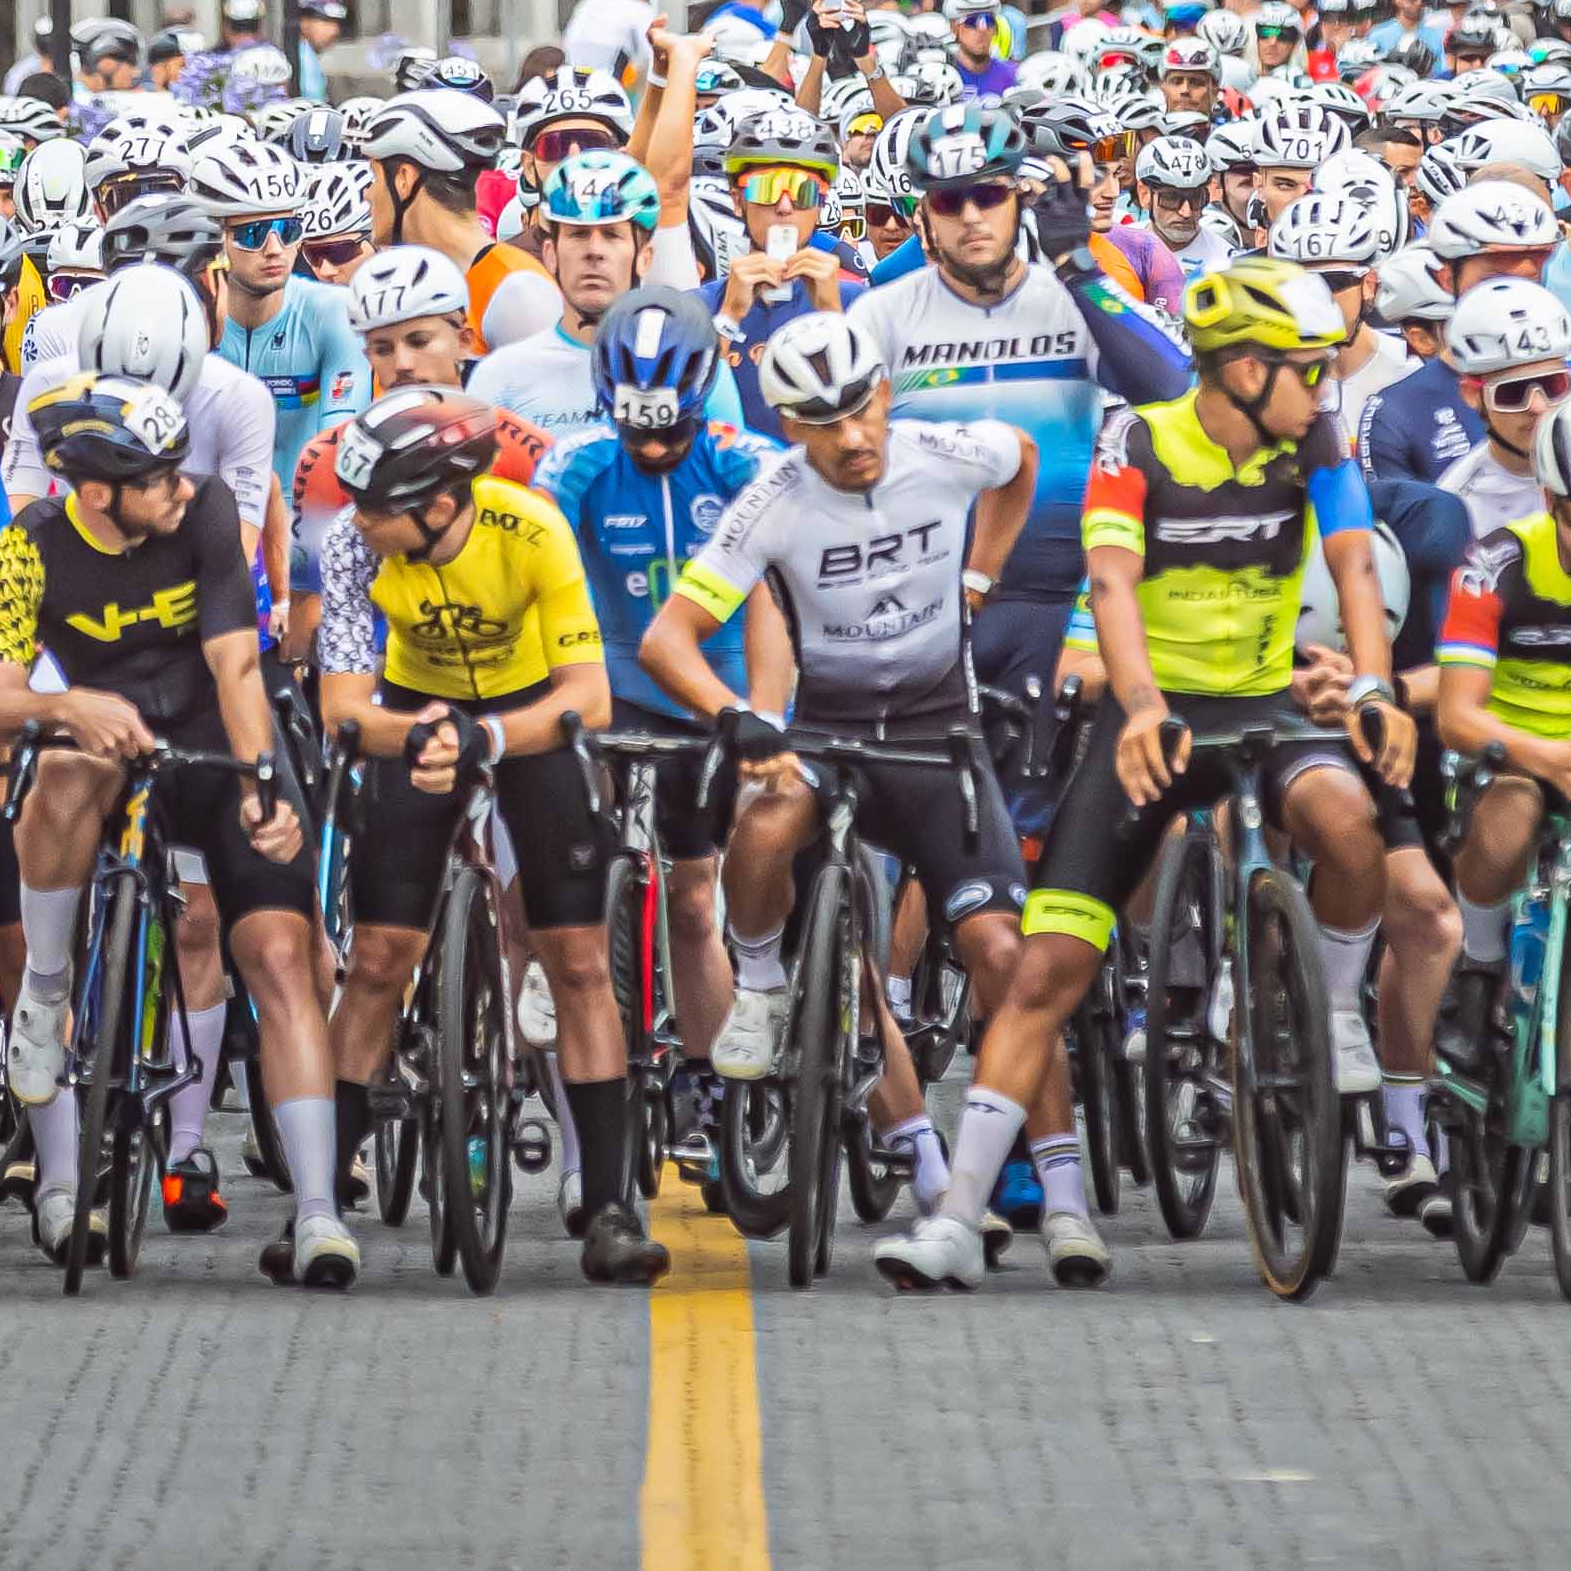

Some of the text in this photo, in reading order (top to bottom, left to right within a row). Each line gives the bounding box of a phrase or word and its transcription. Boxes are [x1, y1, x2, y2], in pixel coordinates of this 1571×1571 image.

[542, 89, 593, 114] 265
[119, 136, 167, 163] 277
[1281, 137, 1323, 160] 701
[935, 147, 989, 181] 175
[1171, 154, 1213, 172] 478
[249, 173, 298, 201] 156
[1293, 232, 1338, 261] 167
[1498, 326, 1551, 360] 143
[621, 402, 673, 428] 159
[817, 519, 943, 578] BRT
